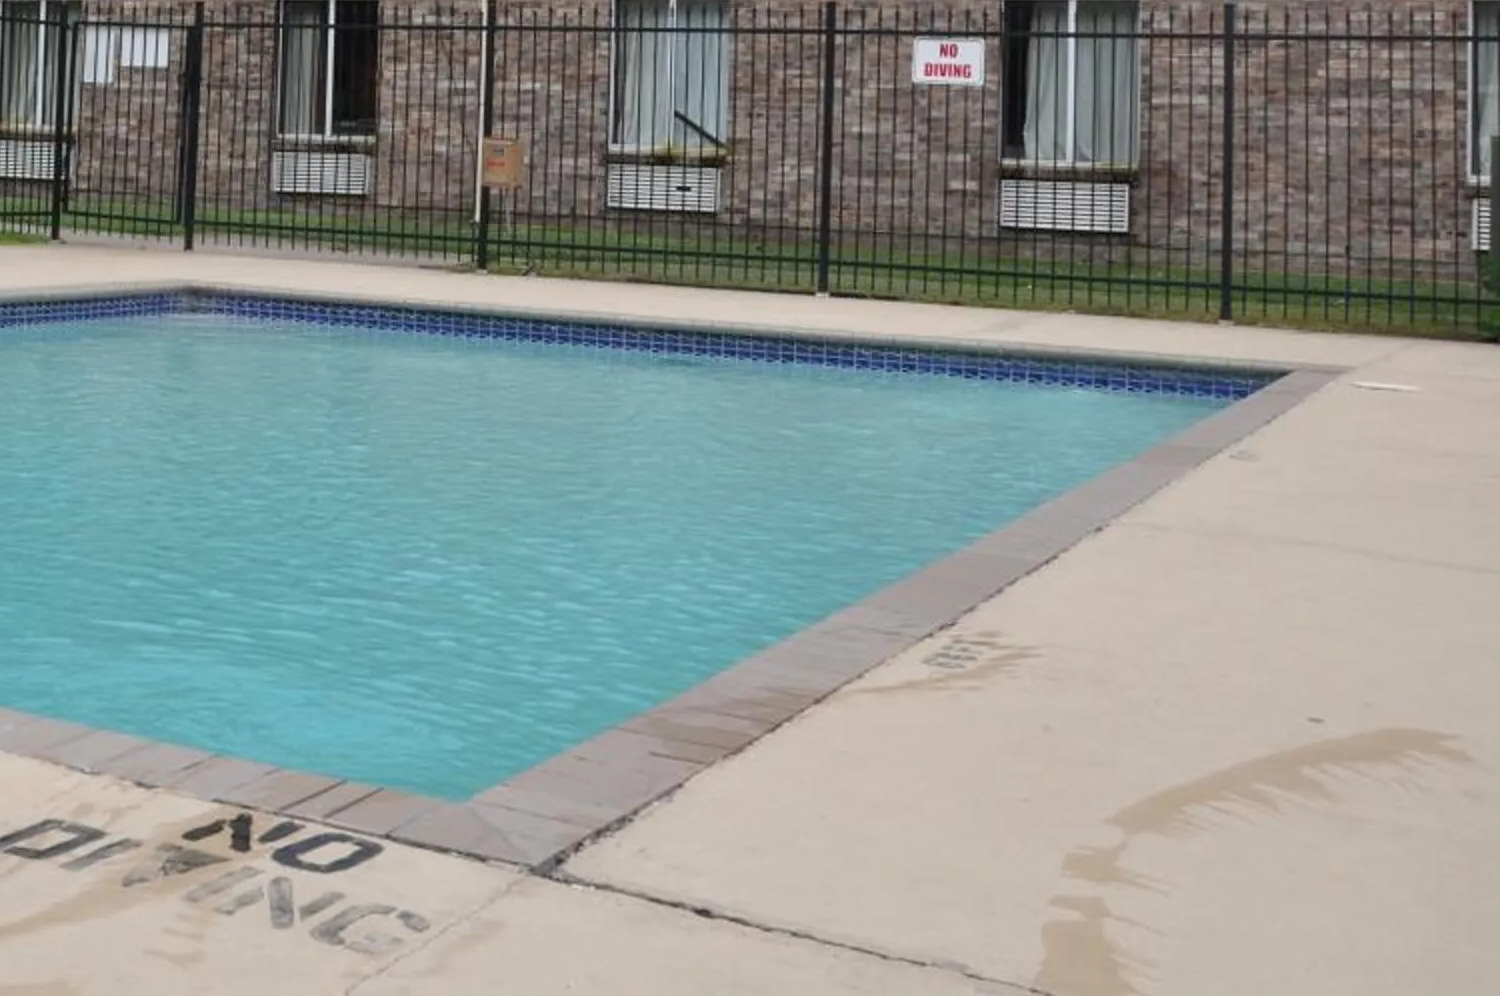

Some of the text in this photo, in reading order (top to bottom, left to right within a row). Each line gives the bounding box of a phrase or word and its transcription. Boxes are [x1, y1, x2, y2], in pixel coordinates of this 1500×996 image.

[939, 43, 959, 58] NO
[923, 62, 972, 79] DIVING
[181, 812, 385, 874] NO
